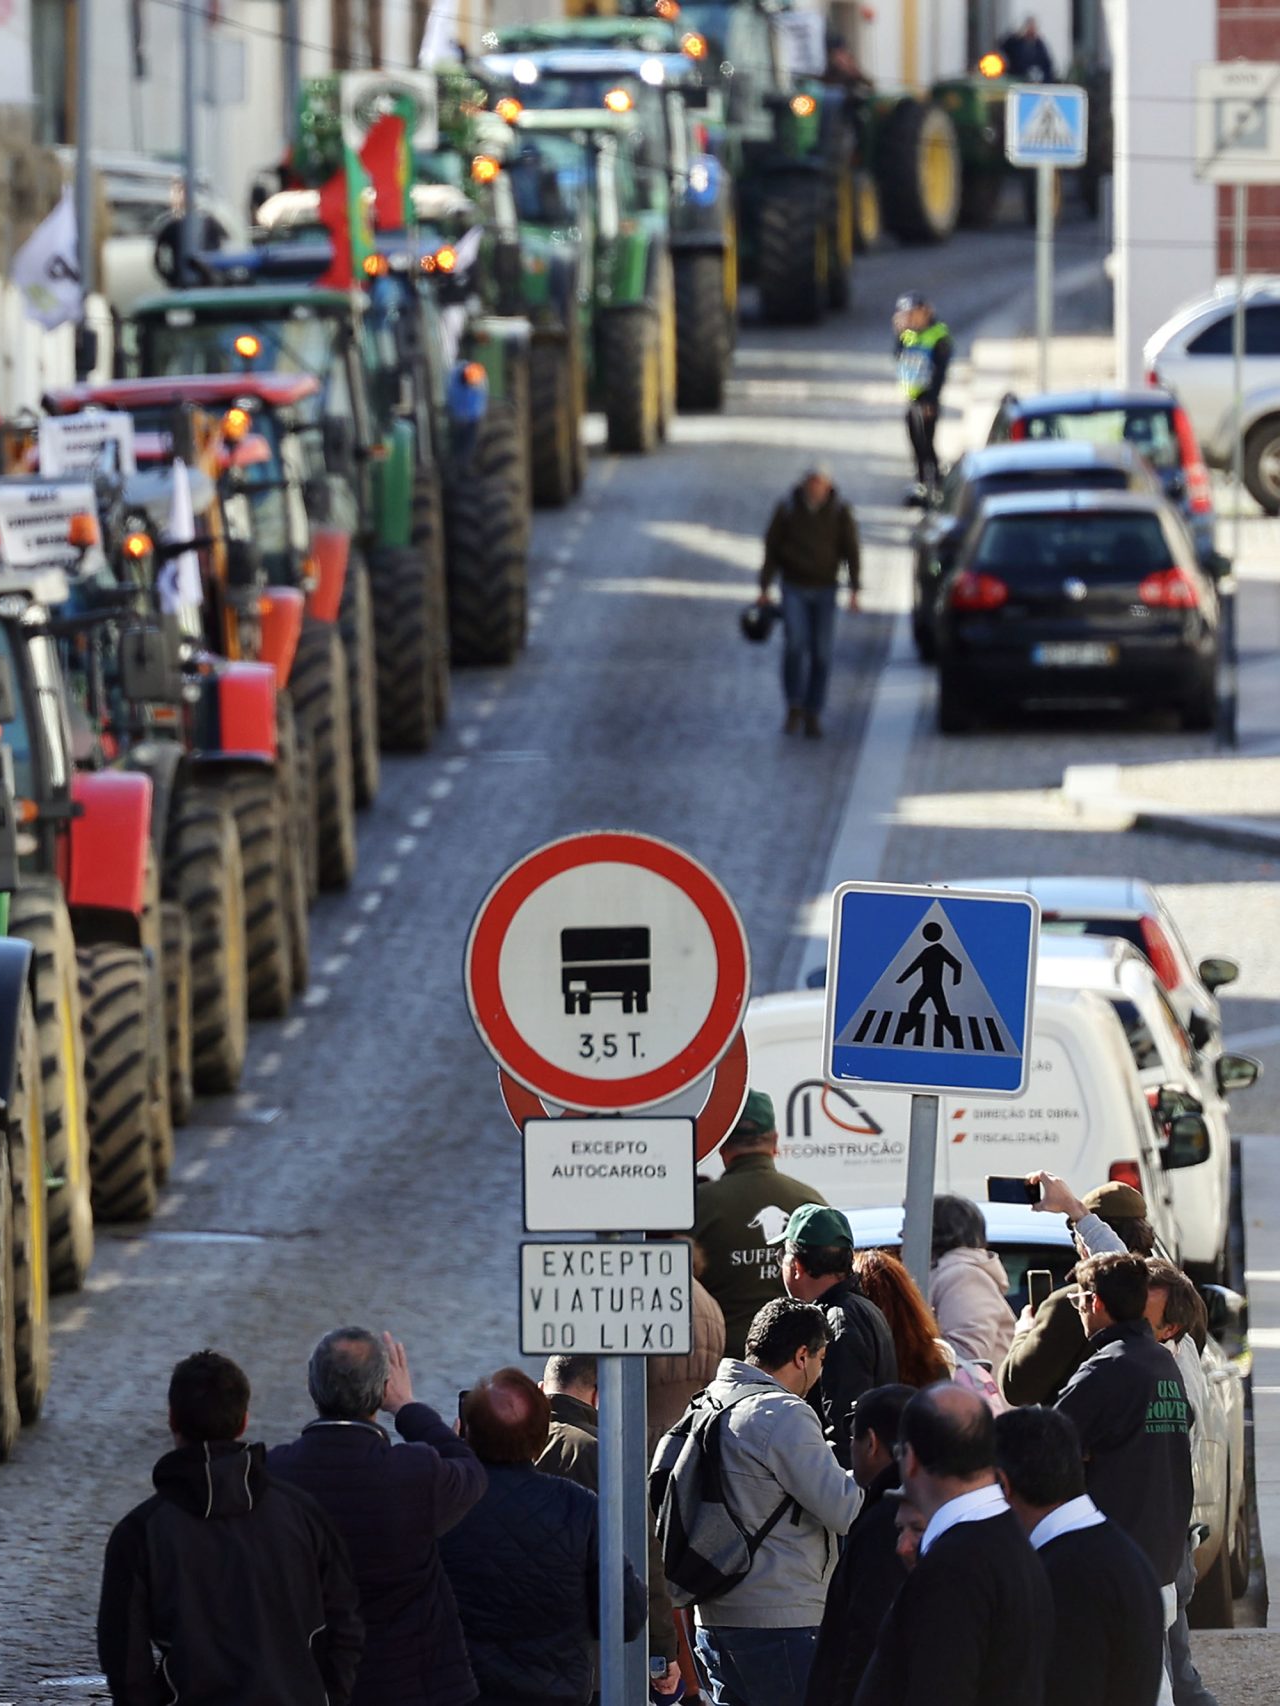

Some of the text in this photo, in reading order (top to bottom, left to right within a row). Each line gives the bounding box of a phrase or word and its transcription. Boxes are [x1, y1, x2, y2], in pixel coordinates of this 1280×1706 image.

[973, 1107, 1079, 1120] DIREÇÃO DE OBRA
[571, 1140, 647, 1156] EXCEPTO
[552, 1164, 667, 1179] AUTOCARROS
[542, 1250, 673, 1277] EXCEPTO
[530, 1287, 684, 1314] VIATURAS
[542, 1322, 674, 1350] DO LIXO
